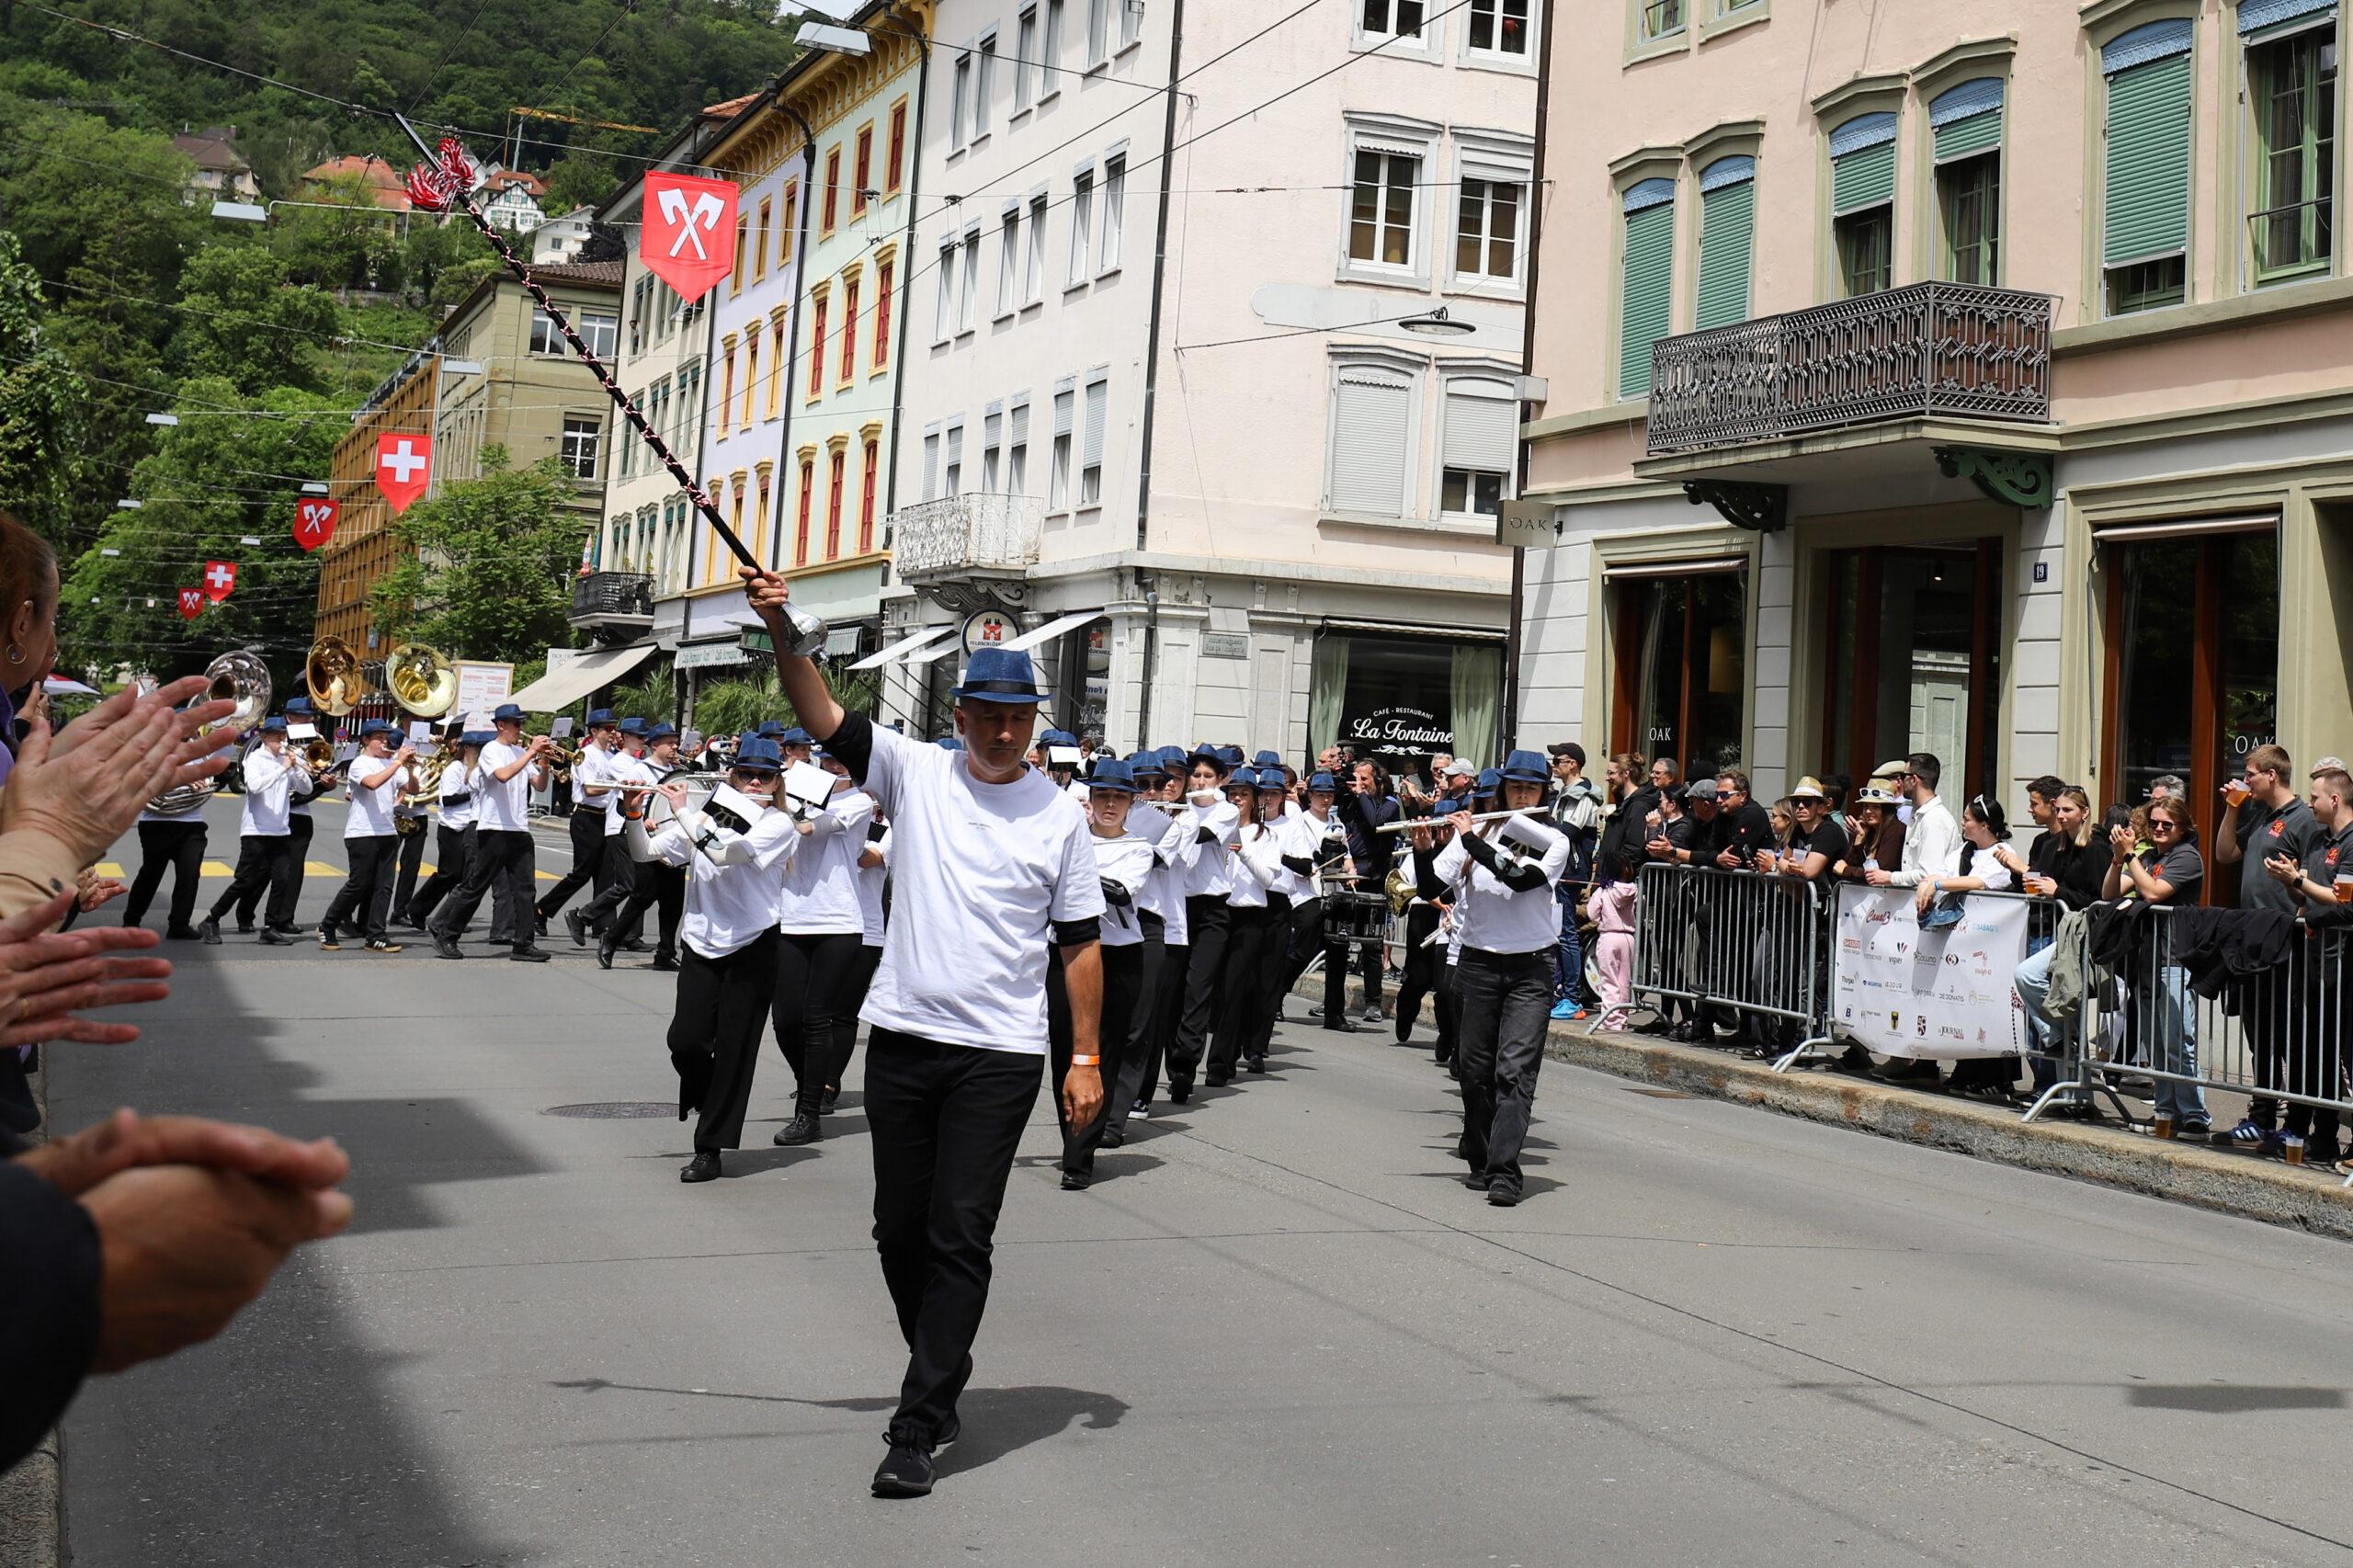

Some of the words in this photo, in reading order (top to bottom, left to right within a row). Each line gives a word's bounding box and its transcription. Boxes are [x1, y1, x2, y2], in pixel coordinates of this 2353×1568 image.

[1509, 517, 1548, 531] OAK
[2035, 563, 2046, 580] 19
[1373, 708, 1390, 717] CAFÉ
[1395, 707, 1434, 720] RESTAURANT
[1350, 718, 1380, 739] La
[1383, 719, 1454, 744] Fontaine
[1649, 727, 1671, 742] OAK
